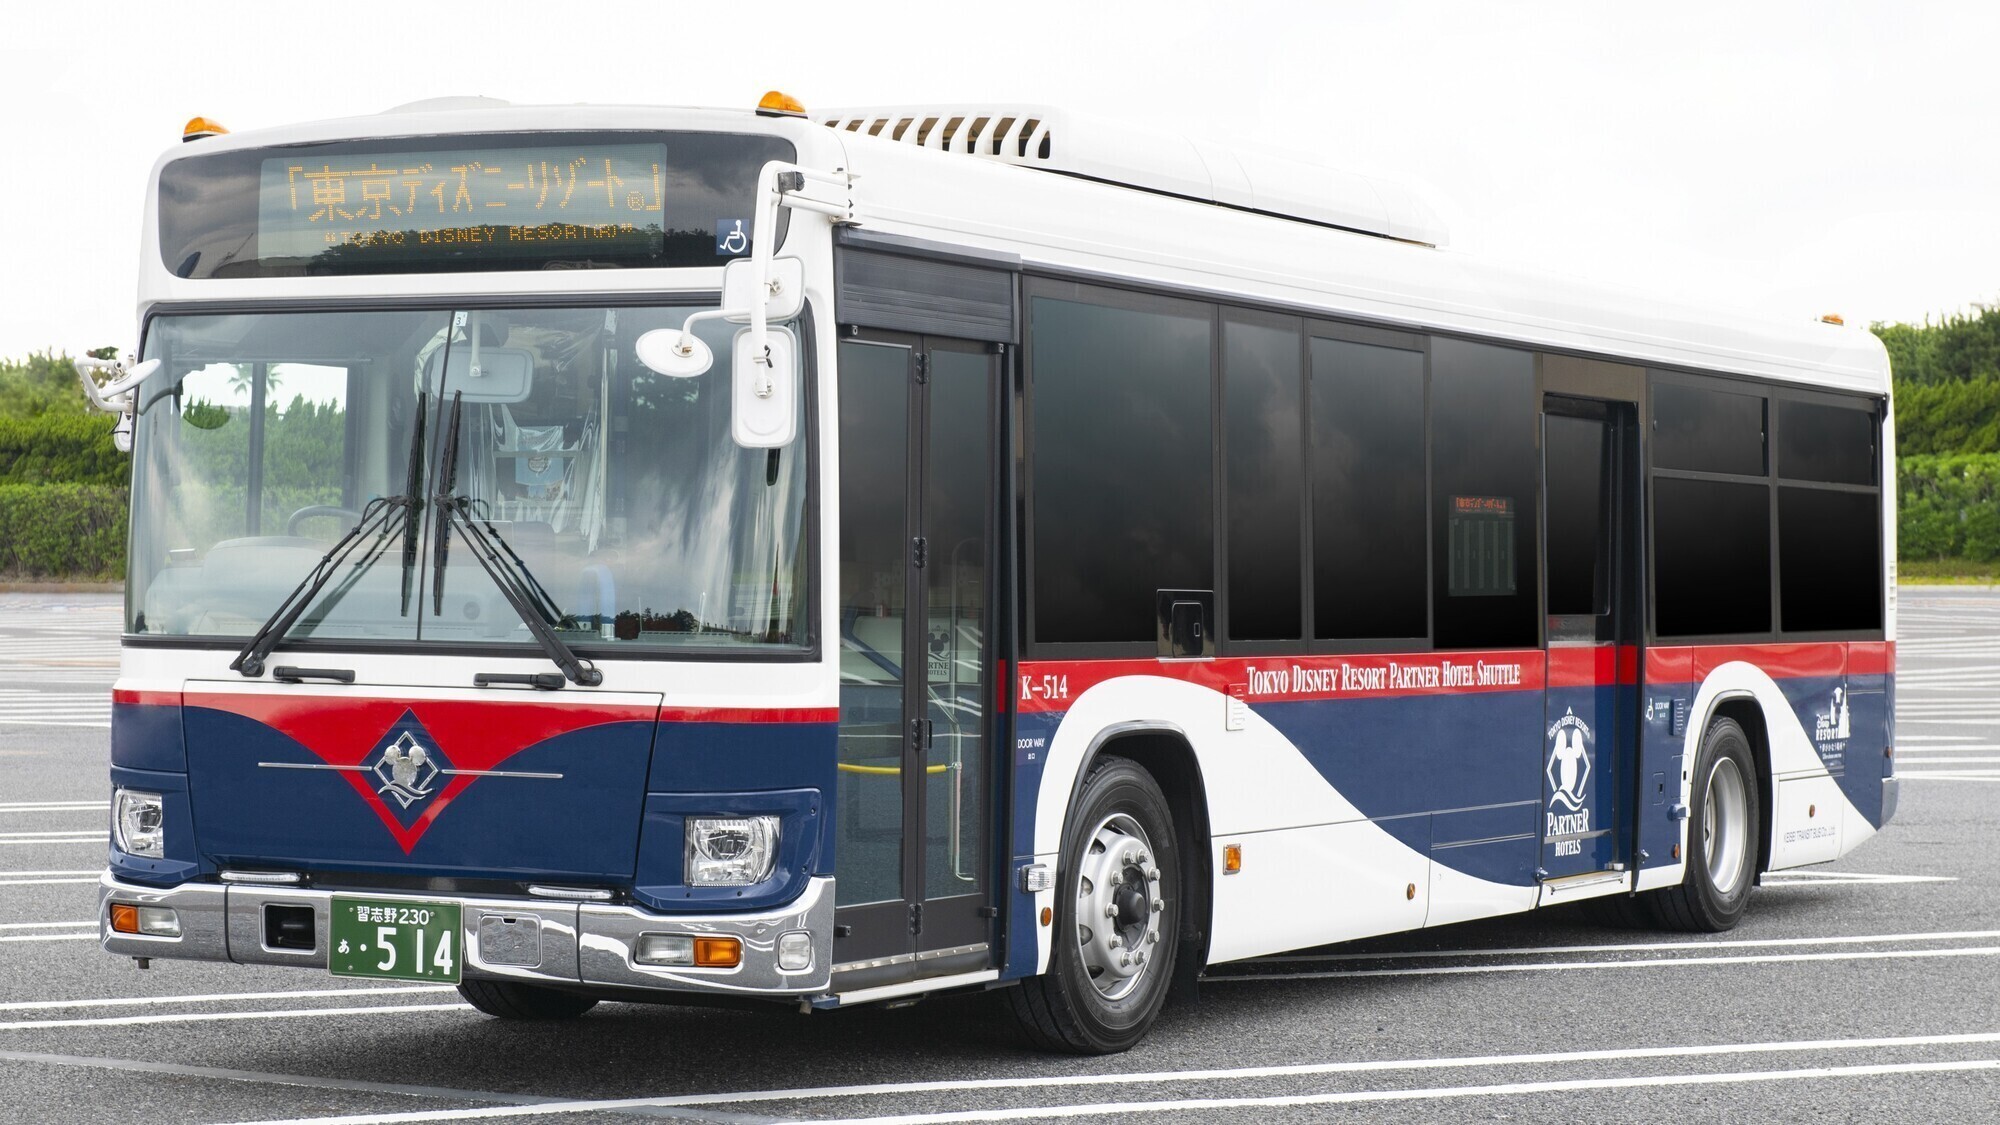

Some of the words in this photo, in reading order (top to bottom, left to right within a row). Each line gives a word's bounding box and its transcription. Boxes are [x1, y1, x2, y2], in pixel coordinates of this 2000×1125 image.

[420, 226, 495, 244] DISNEY
[1247, 666, 1289, 695] TOKYO
[1292, 665, 1338, 693] DISNEY
[1341, 663, 1387, 691] RESORT
[1389, 662, 1439, 689] PARTNER
[1442, 660, 1474, 687] HOTEL
[1477, 659, 1521, 686] SHUTTLE
[1017, 739, 1033, 749] DOOR
[1033, 737, 1045, 748] WAY
[1546, 808, 1590, 837] PARTNER
[1554, 839, 1582, 858] HOTELS
[337, 939, 350, 955] あ
